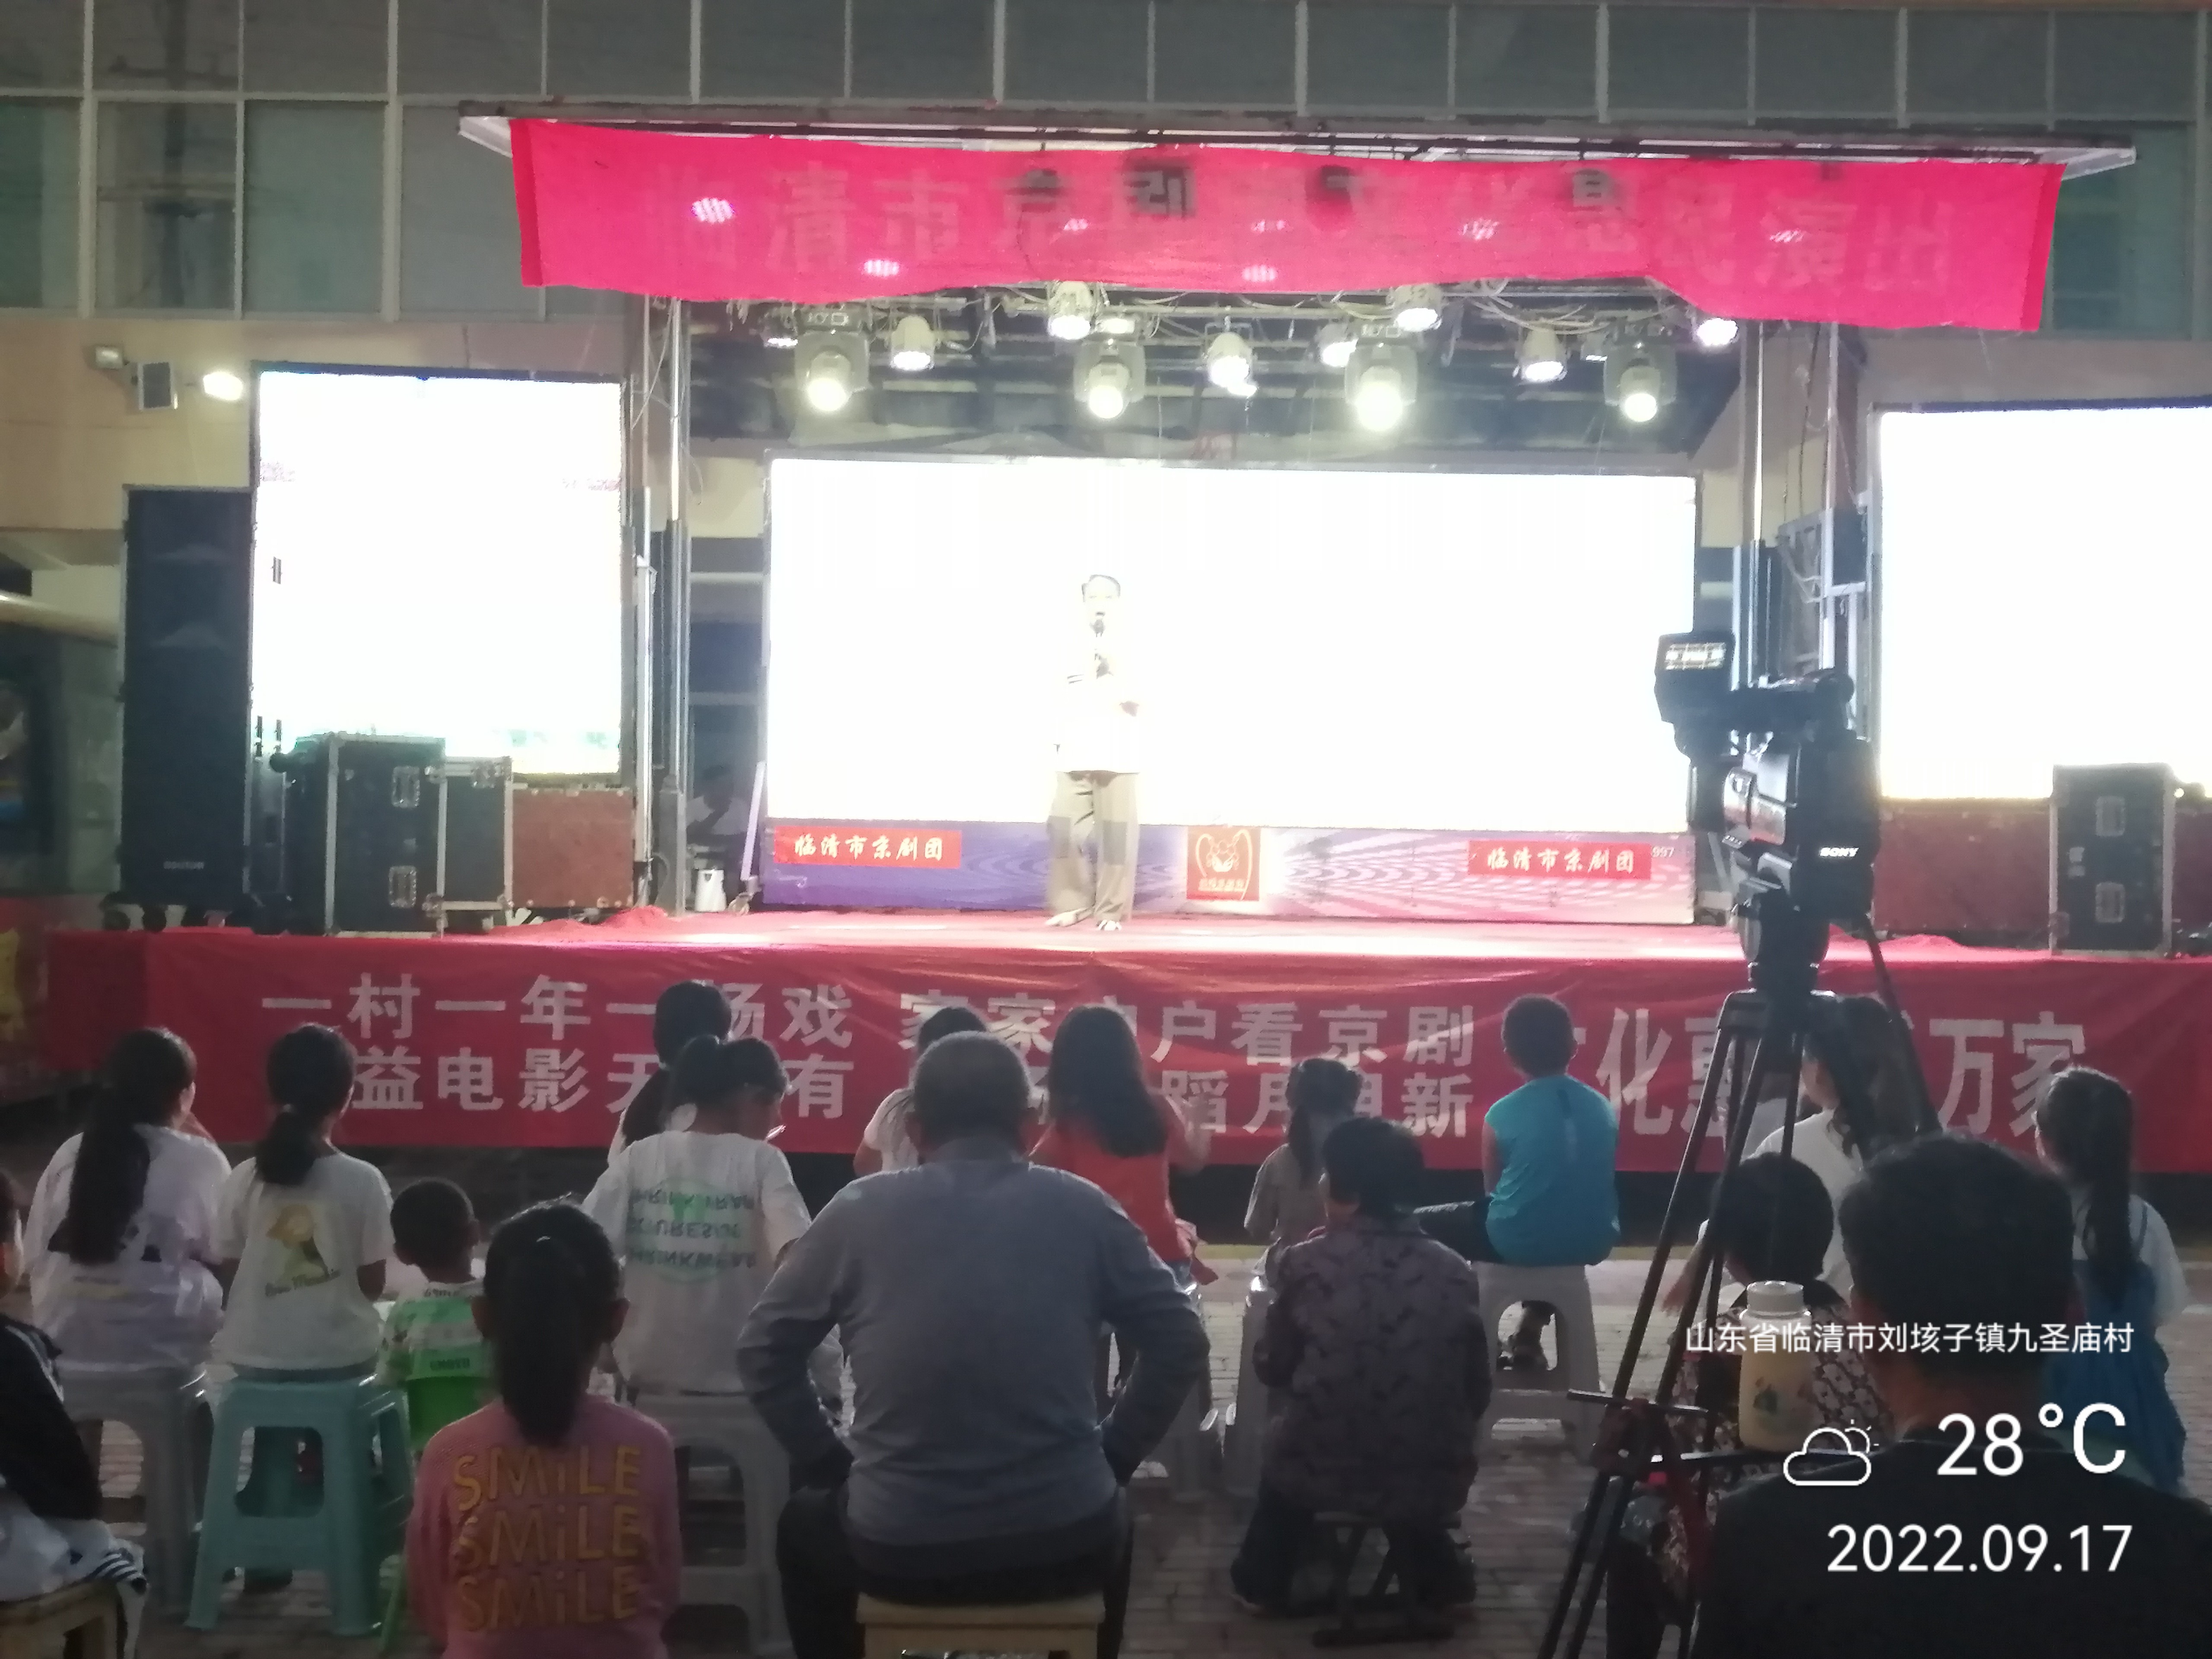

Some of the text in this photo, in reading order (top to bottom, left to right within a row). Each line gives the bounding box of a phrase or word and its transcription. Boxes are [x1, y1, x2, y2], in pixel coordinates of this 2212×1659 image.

[794, 833, 944, 861] 临清市京剧团
[1487, 846, 1634, 874] 临清市京剧团
[1819, 847, 1859, 857] SONY
[898, 989, 1474, 1067] 家家户看京剧
